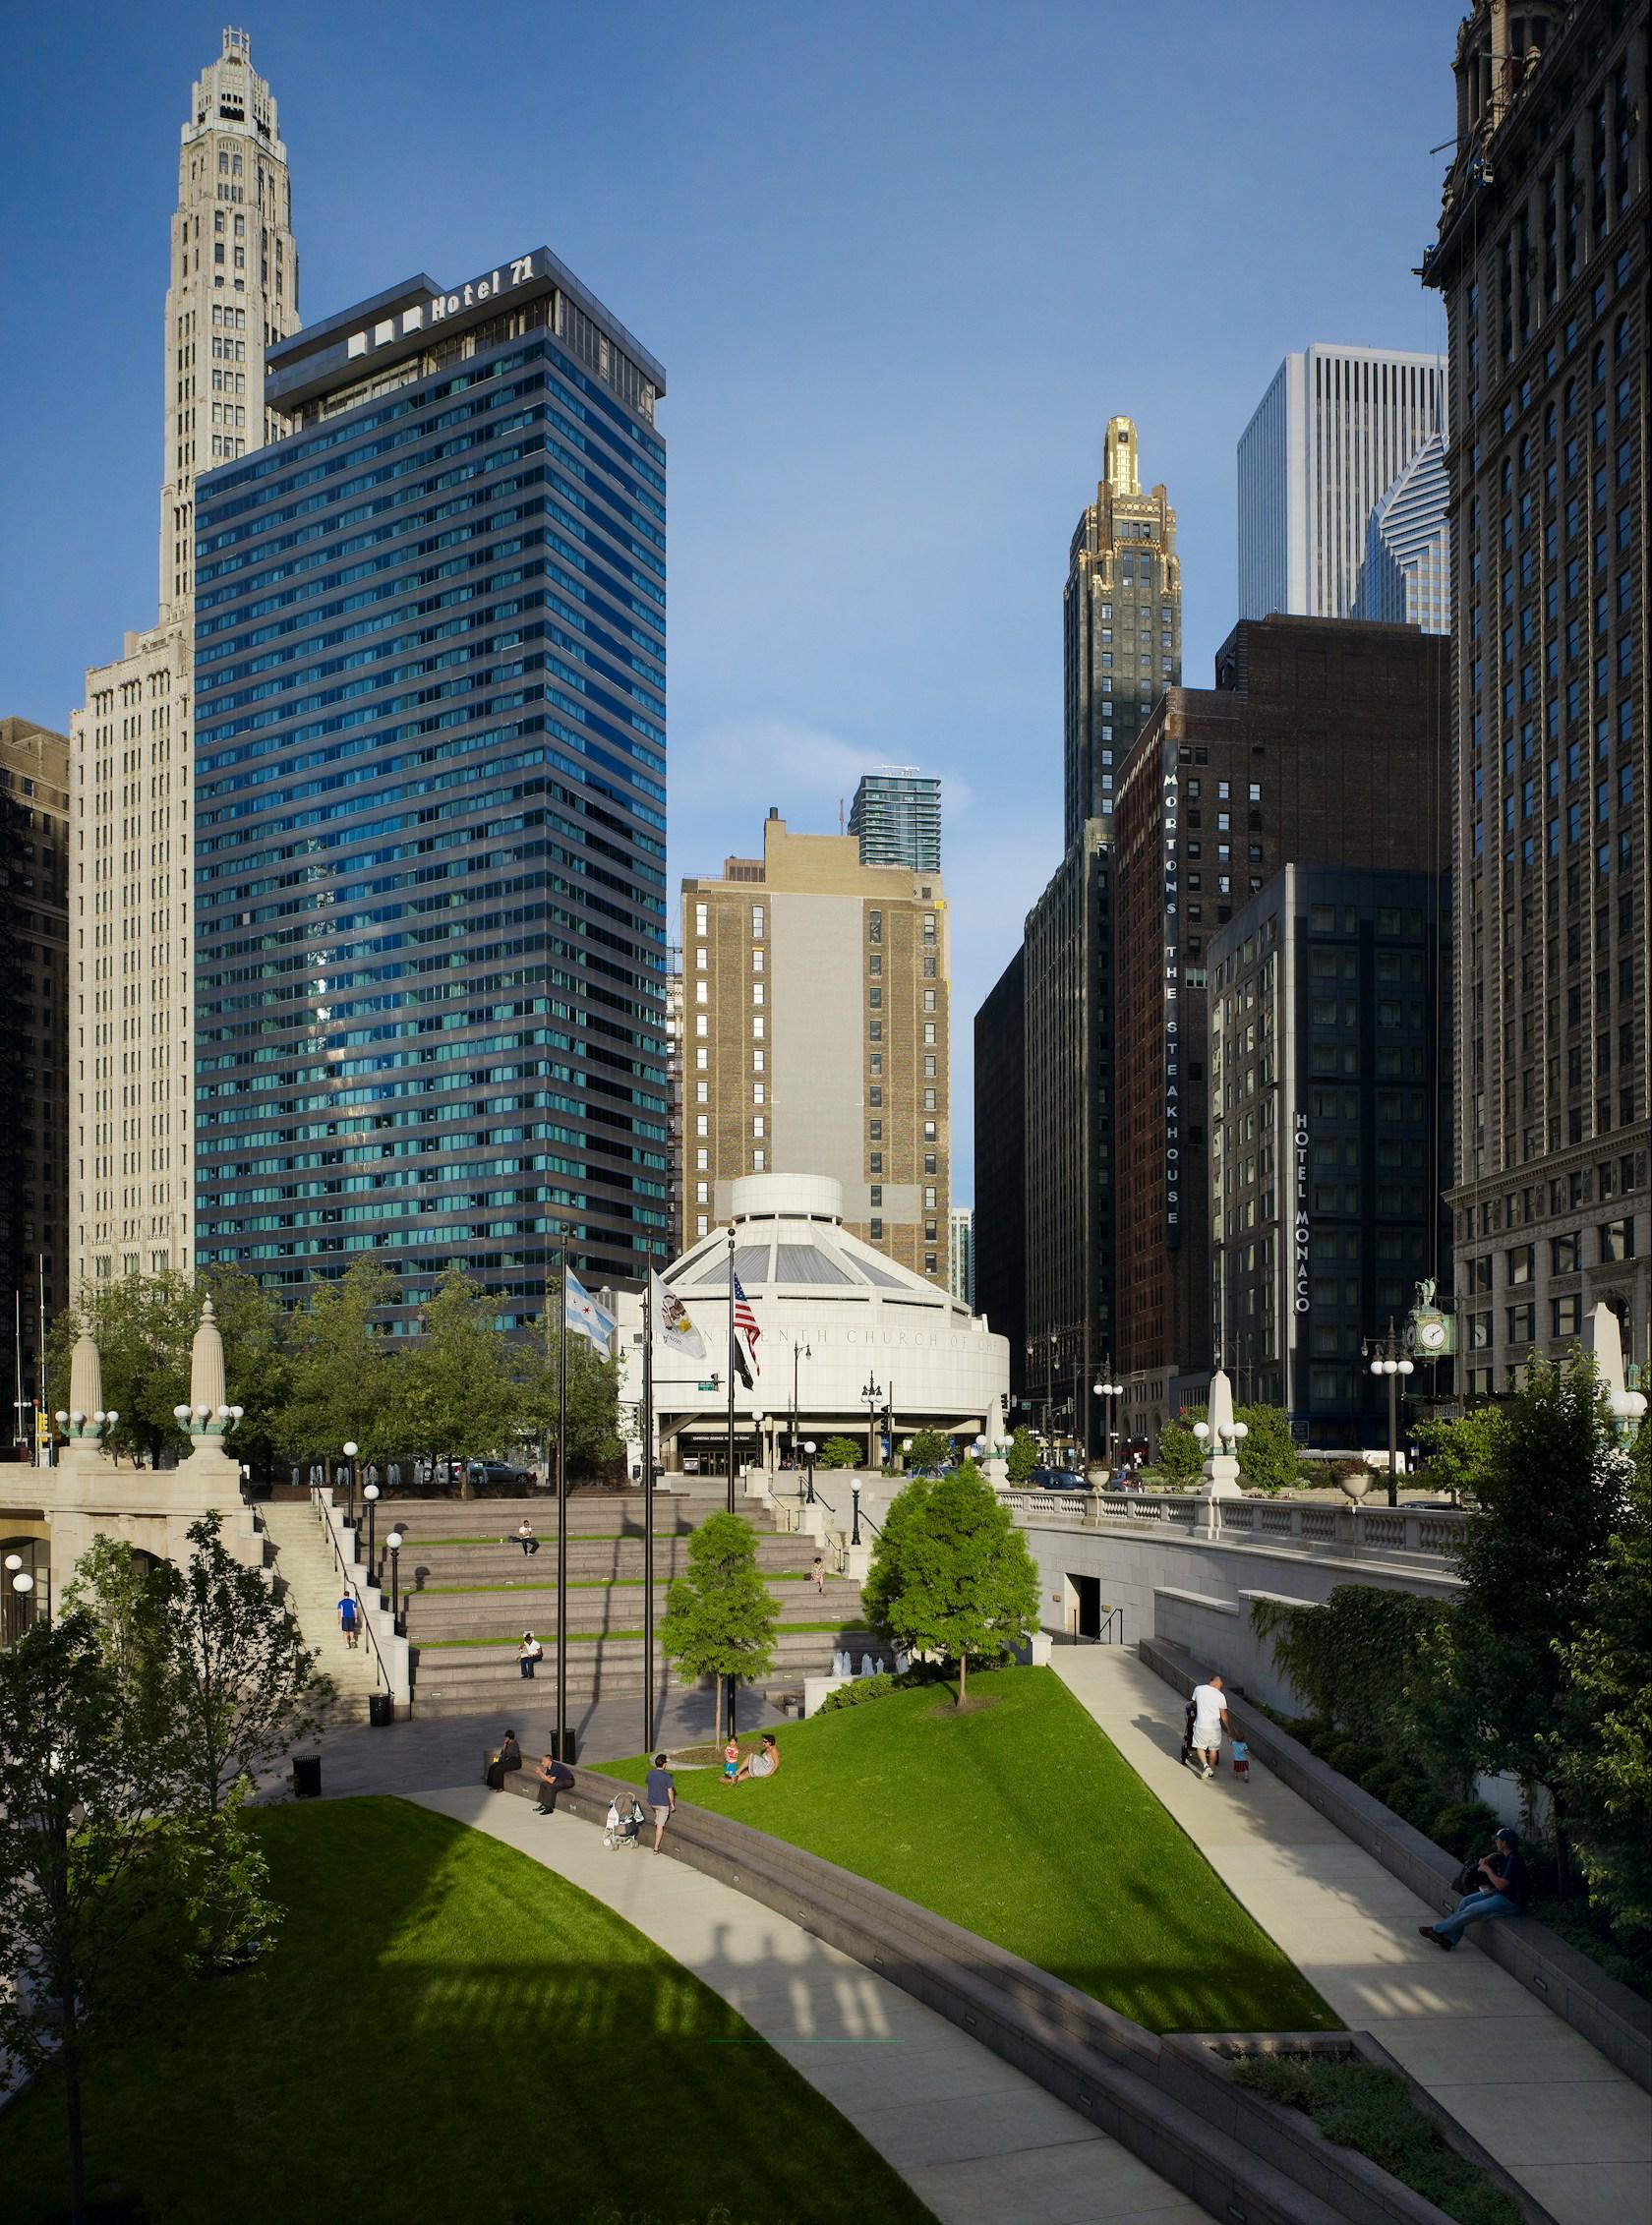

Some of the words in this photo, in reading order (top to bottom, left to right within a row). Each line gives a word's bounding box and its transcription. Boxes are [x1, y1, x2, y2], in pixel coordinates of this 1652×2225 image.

[432, 270, 500, 322] Hotel
[510, 256, 534, 285] 71
[1163, 774, 1178, 914] MORTONS
[1166, 947, 1177, 999] THE
[1166, 1022, 1178, 1224] STEAKHOUSE
[1295, 1114, 1309, 1198] HOTEL
[1295, 1210, 1310, 1313] MONACO
[847, 1329, 937, 1346] CHURCH
[950, 1335, 969, 1349] OF
